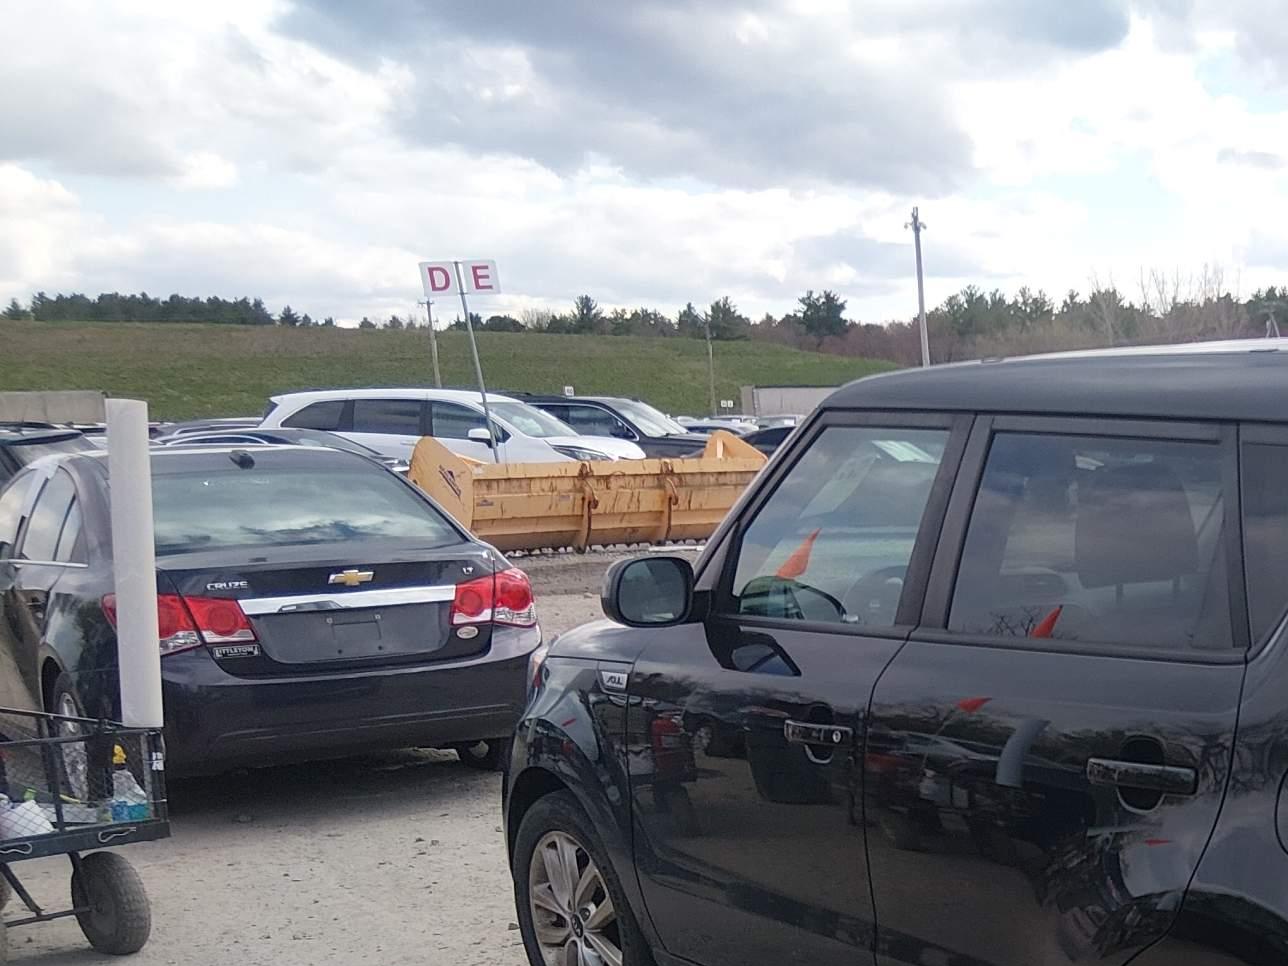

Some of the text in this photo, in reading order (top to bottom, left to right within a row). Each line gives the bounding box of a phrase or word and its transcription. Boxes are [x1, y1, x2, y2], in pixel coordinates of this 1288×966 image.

[427, 266, 451, 292] D
[471, 265, 494, 290] E
[462, 566, 474, 575] LT
[206, 581, 249, 591] CRUZE
